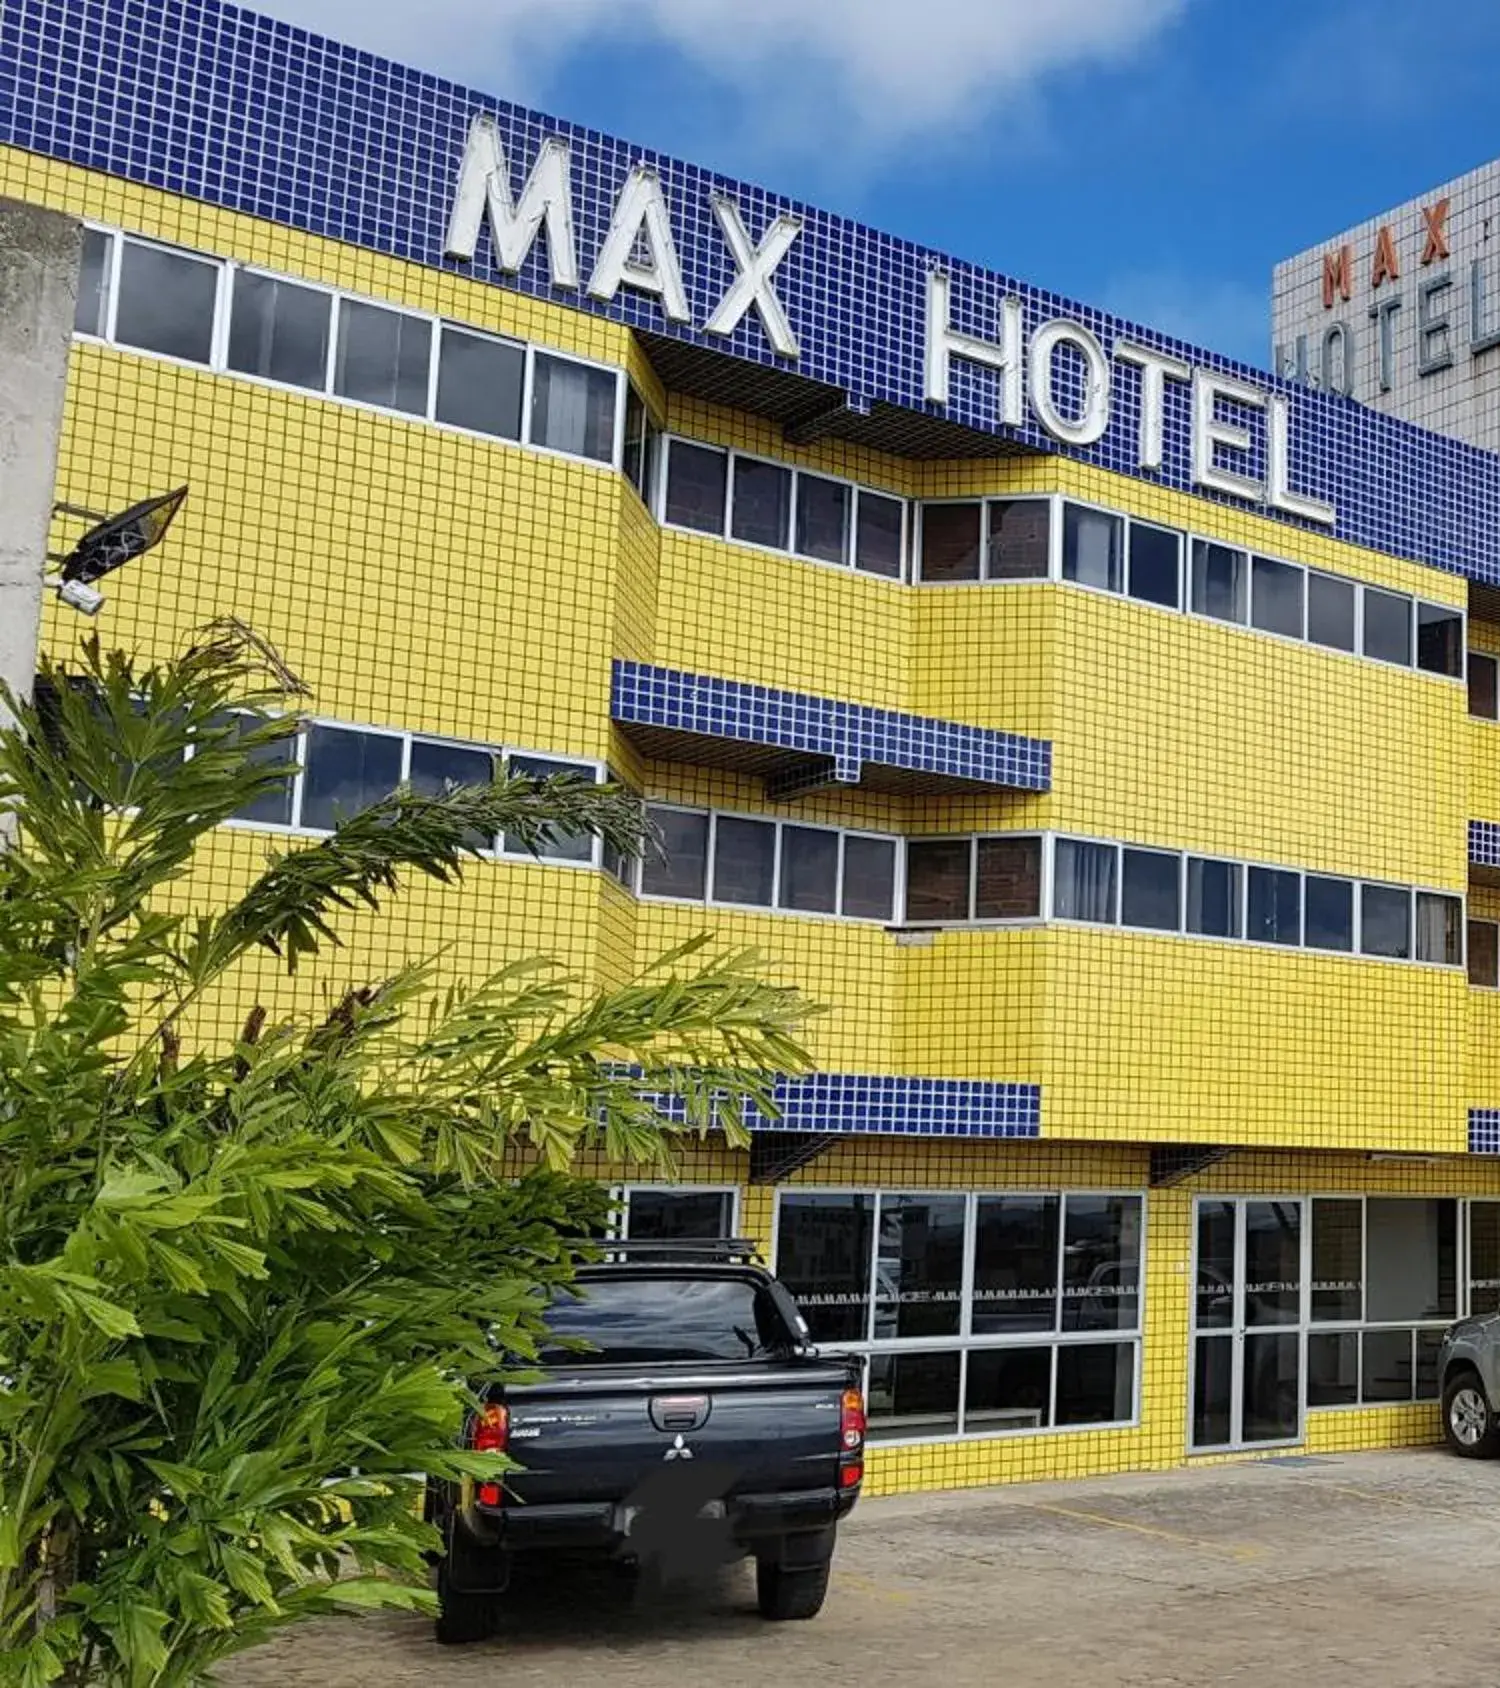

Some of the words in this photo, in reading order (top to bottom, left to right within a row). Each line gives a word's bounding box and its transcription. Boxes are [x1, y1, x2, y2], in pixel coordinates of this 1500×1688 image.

[444, 111, 801, 358] MAX
[924, 265, 1337, 523] HOTEL
[1322, 197, 1450, 309] MAX
